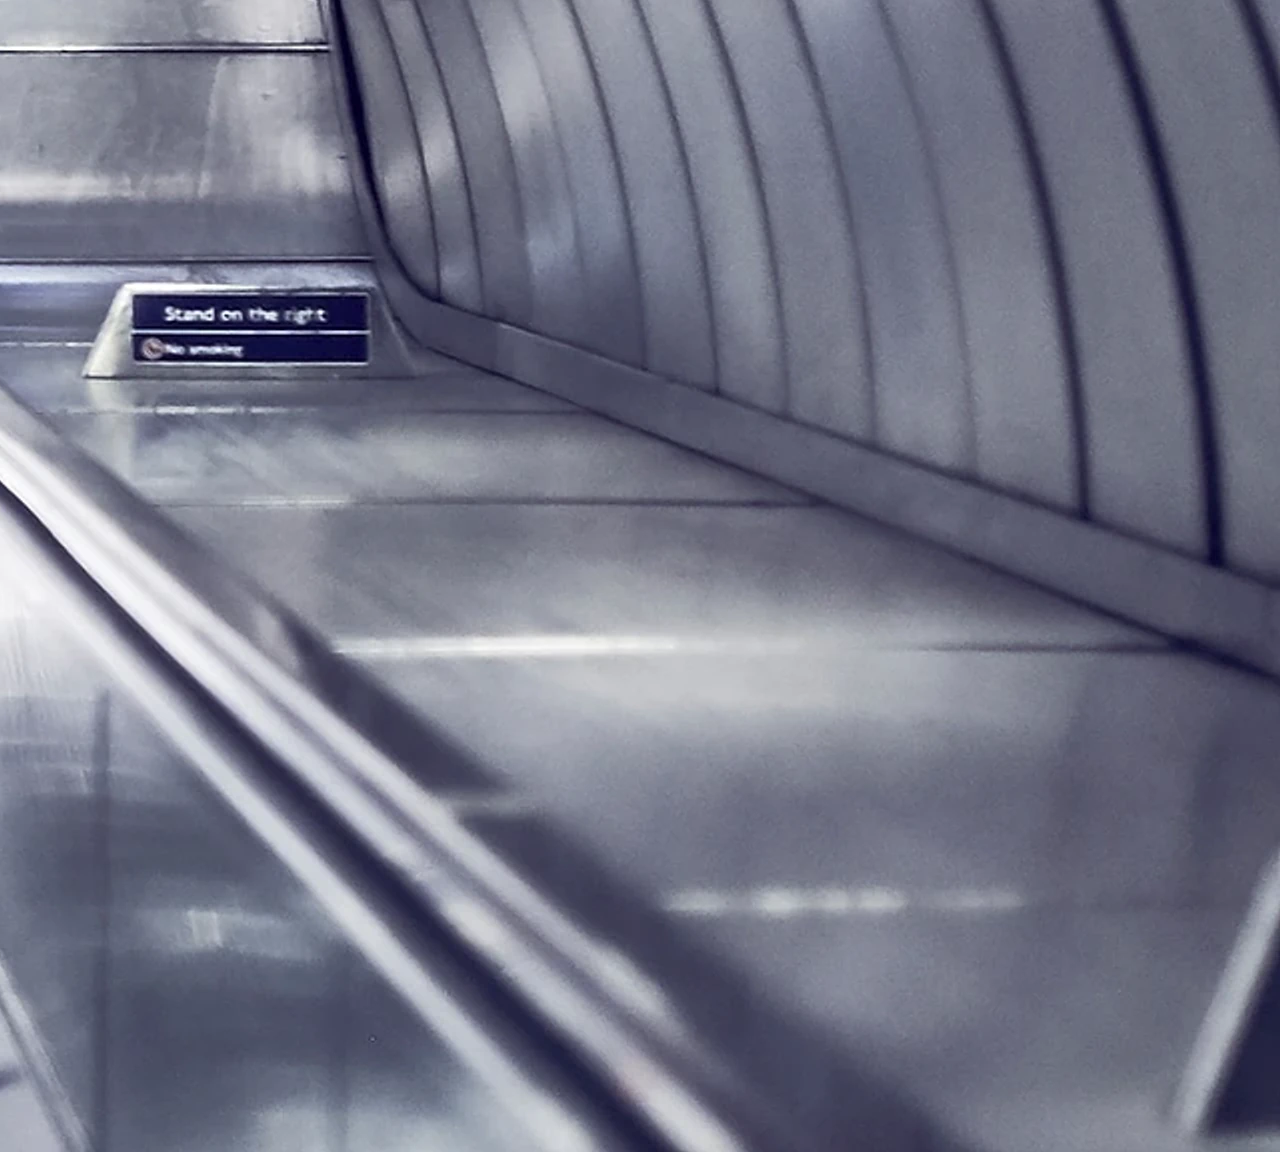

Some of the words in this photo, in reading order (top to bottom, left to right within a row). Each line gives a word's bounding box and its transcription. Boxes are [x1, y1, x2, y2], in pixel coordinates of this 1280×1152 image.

[164, 306, 215, 322] Stand
[221, 310, 243, 322] on
[249, 307, 278, 322] the
[285, 307, 328, 326] right
[165, 343, 185, 355] No
[189, 343, 244, 357] smoking
